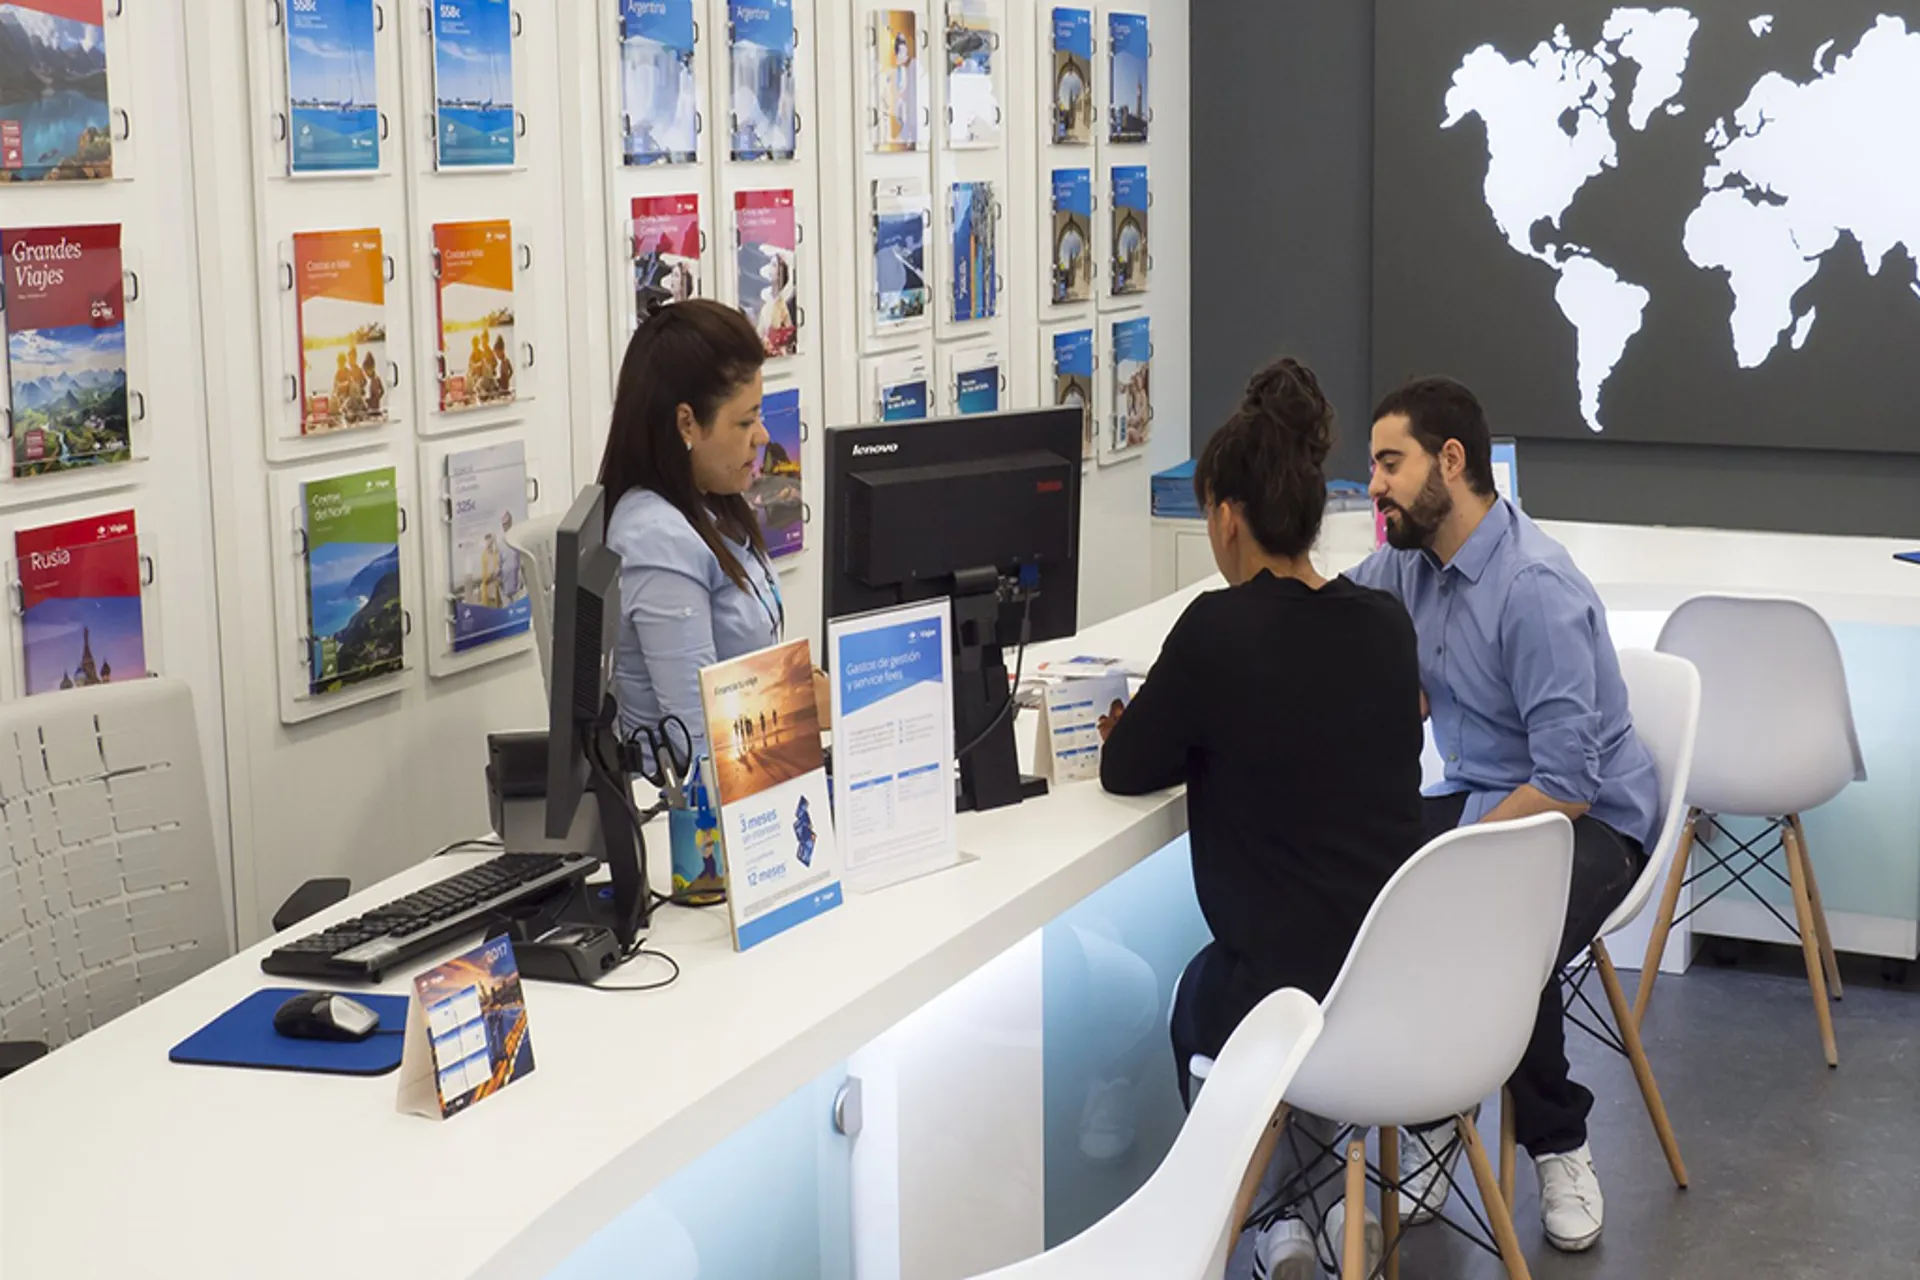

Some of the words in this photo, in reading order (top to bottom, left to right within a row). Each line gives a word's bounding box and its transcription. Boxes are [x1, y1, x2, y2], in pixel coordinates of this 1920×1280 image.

[12, 236, 82, 263] Grandes
[14, 264, 64, 291] Viajes
[852, 443, 899, 456] lenovo
[30, 546, 71, 571] Rusia
[740, 818, 748, 833] 3
[748, 808, 777, 829] meses
[748, 871, 758, 887] 12
[759, 862, 787, 883] meses
[484, 942, 507, 964] 2017
